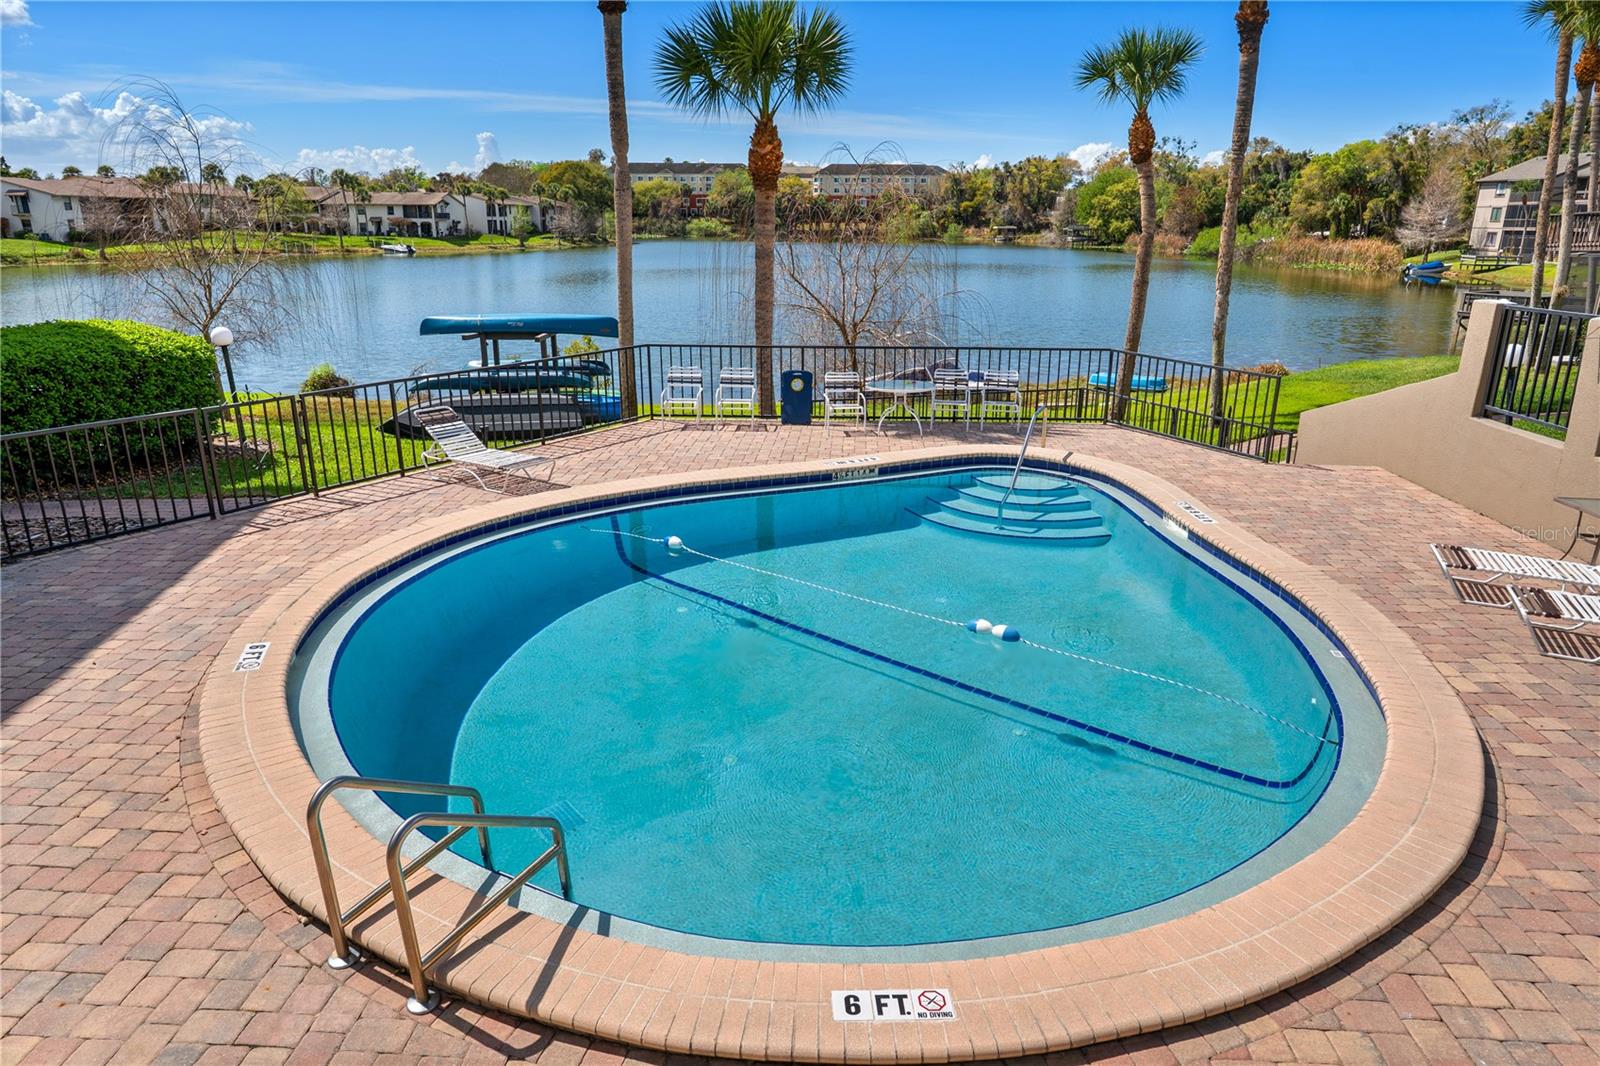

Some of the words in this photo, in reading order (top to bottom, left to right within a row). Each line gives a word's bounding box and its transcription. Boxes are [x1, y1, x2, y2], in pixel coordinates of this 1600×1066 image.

[844, 994, 861, 1016] 6
[874, 993, 911, 1016] FT.
[929, 1011, 953, 1019] DIVING
